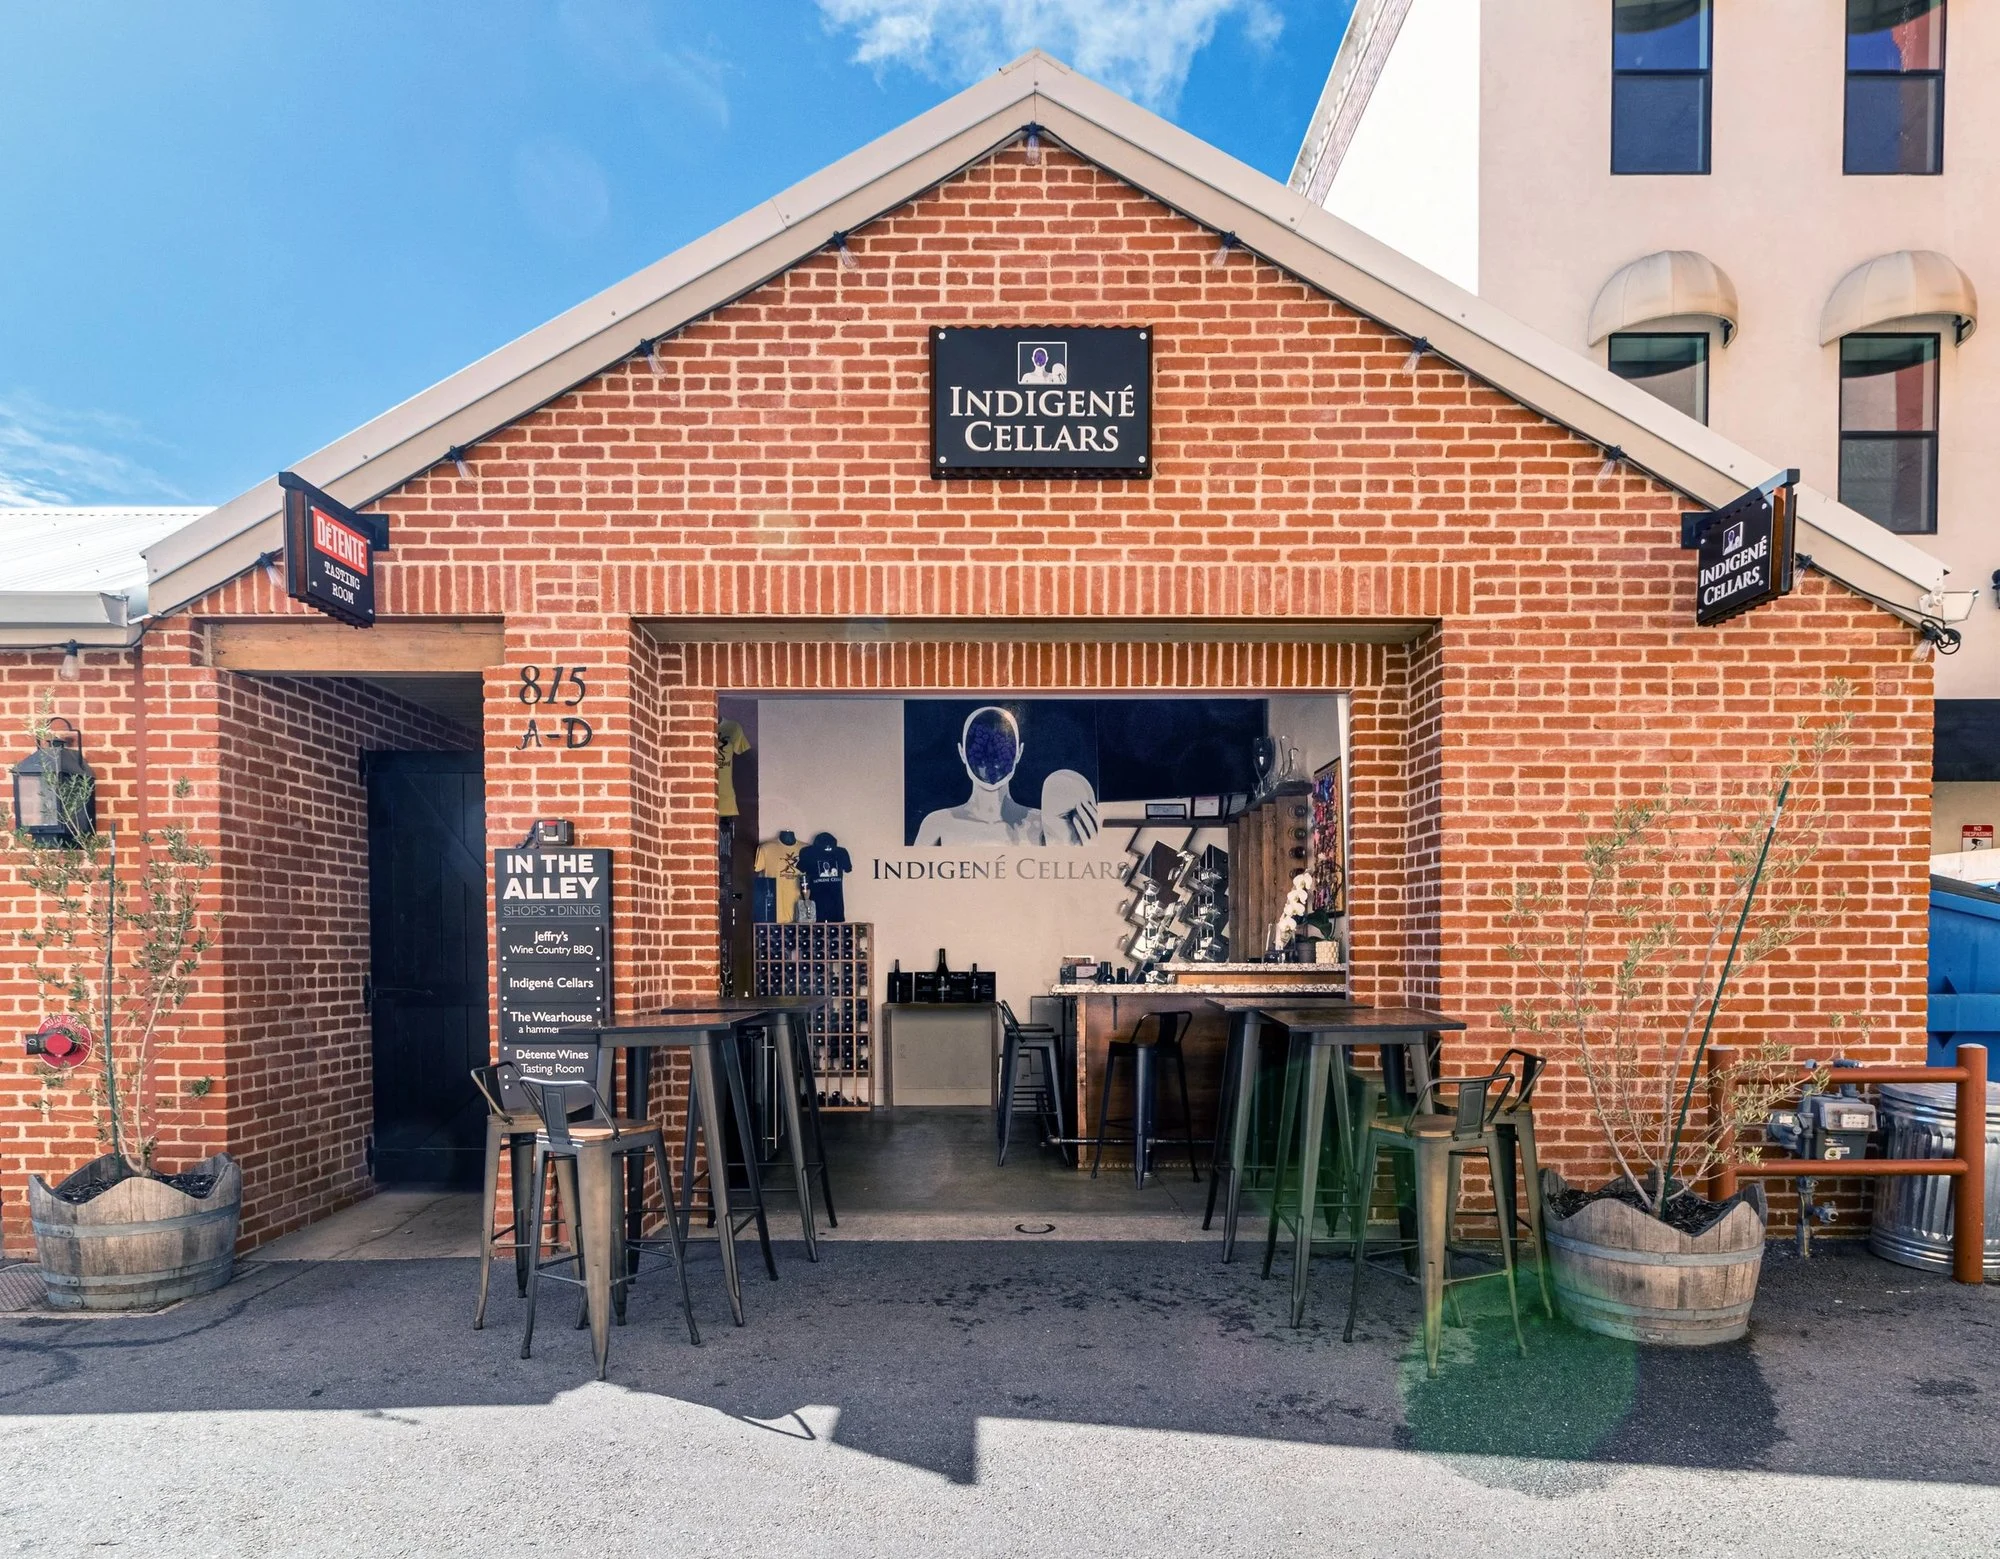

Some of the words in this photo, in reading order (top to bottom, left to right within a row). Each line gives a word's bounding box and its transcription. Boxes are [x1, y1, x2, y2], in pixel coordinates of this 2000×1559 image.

[950, 385, 1135, 417] INDIGENÉ
[964, 421, 1119, 452] CELLARS
[316, 516, 365, 569] DÉTENTE
[1700, 536, 1768, 588] INDIGENÉ
[324, 561, 360, 590] TASTING
[1703, 566, 1760, 605] CELLARS
[332, 583, 354, 605] ROOM
[519, 665, 587, 705] 815
[507, 854, 533, 874] IN
[541, 854, 594, 874] THE
[872, 855, 1006, 880] INDIGENÉ
[503, 877, 600, 900] ALLEY
[503, 905, 547, 916] SHOPS
[557, 905, 601, 916] DINING
[533, 931, 569, 944] Jeffry's
[509, 945, 534, 954] Wine
[535, 945, 571, 956] Country
[573, 945, 594, 955] BBQ
[509, 977, 554, 991] Indigené
[556, 977, 594, 988] Cellars
[510, 1011, 531, 1022] The
[531, 1011, 593, 1022] Wearhouse
[518, 1026, 524, 1034] a
[516, 1049, 557, 1060] Détente
[557, 1050, 589, 1060] Wines
[520, 1063, 553, 1075] Tasting
[555, 1064, 585, 1073] Room
